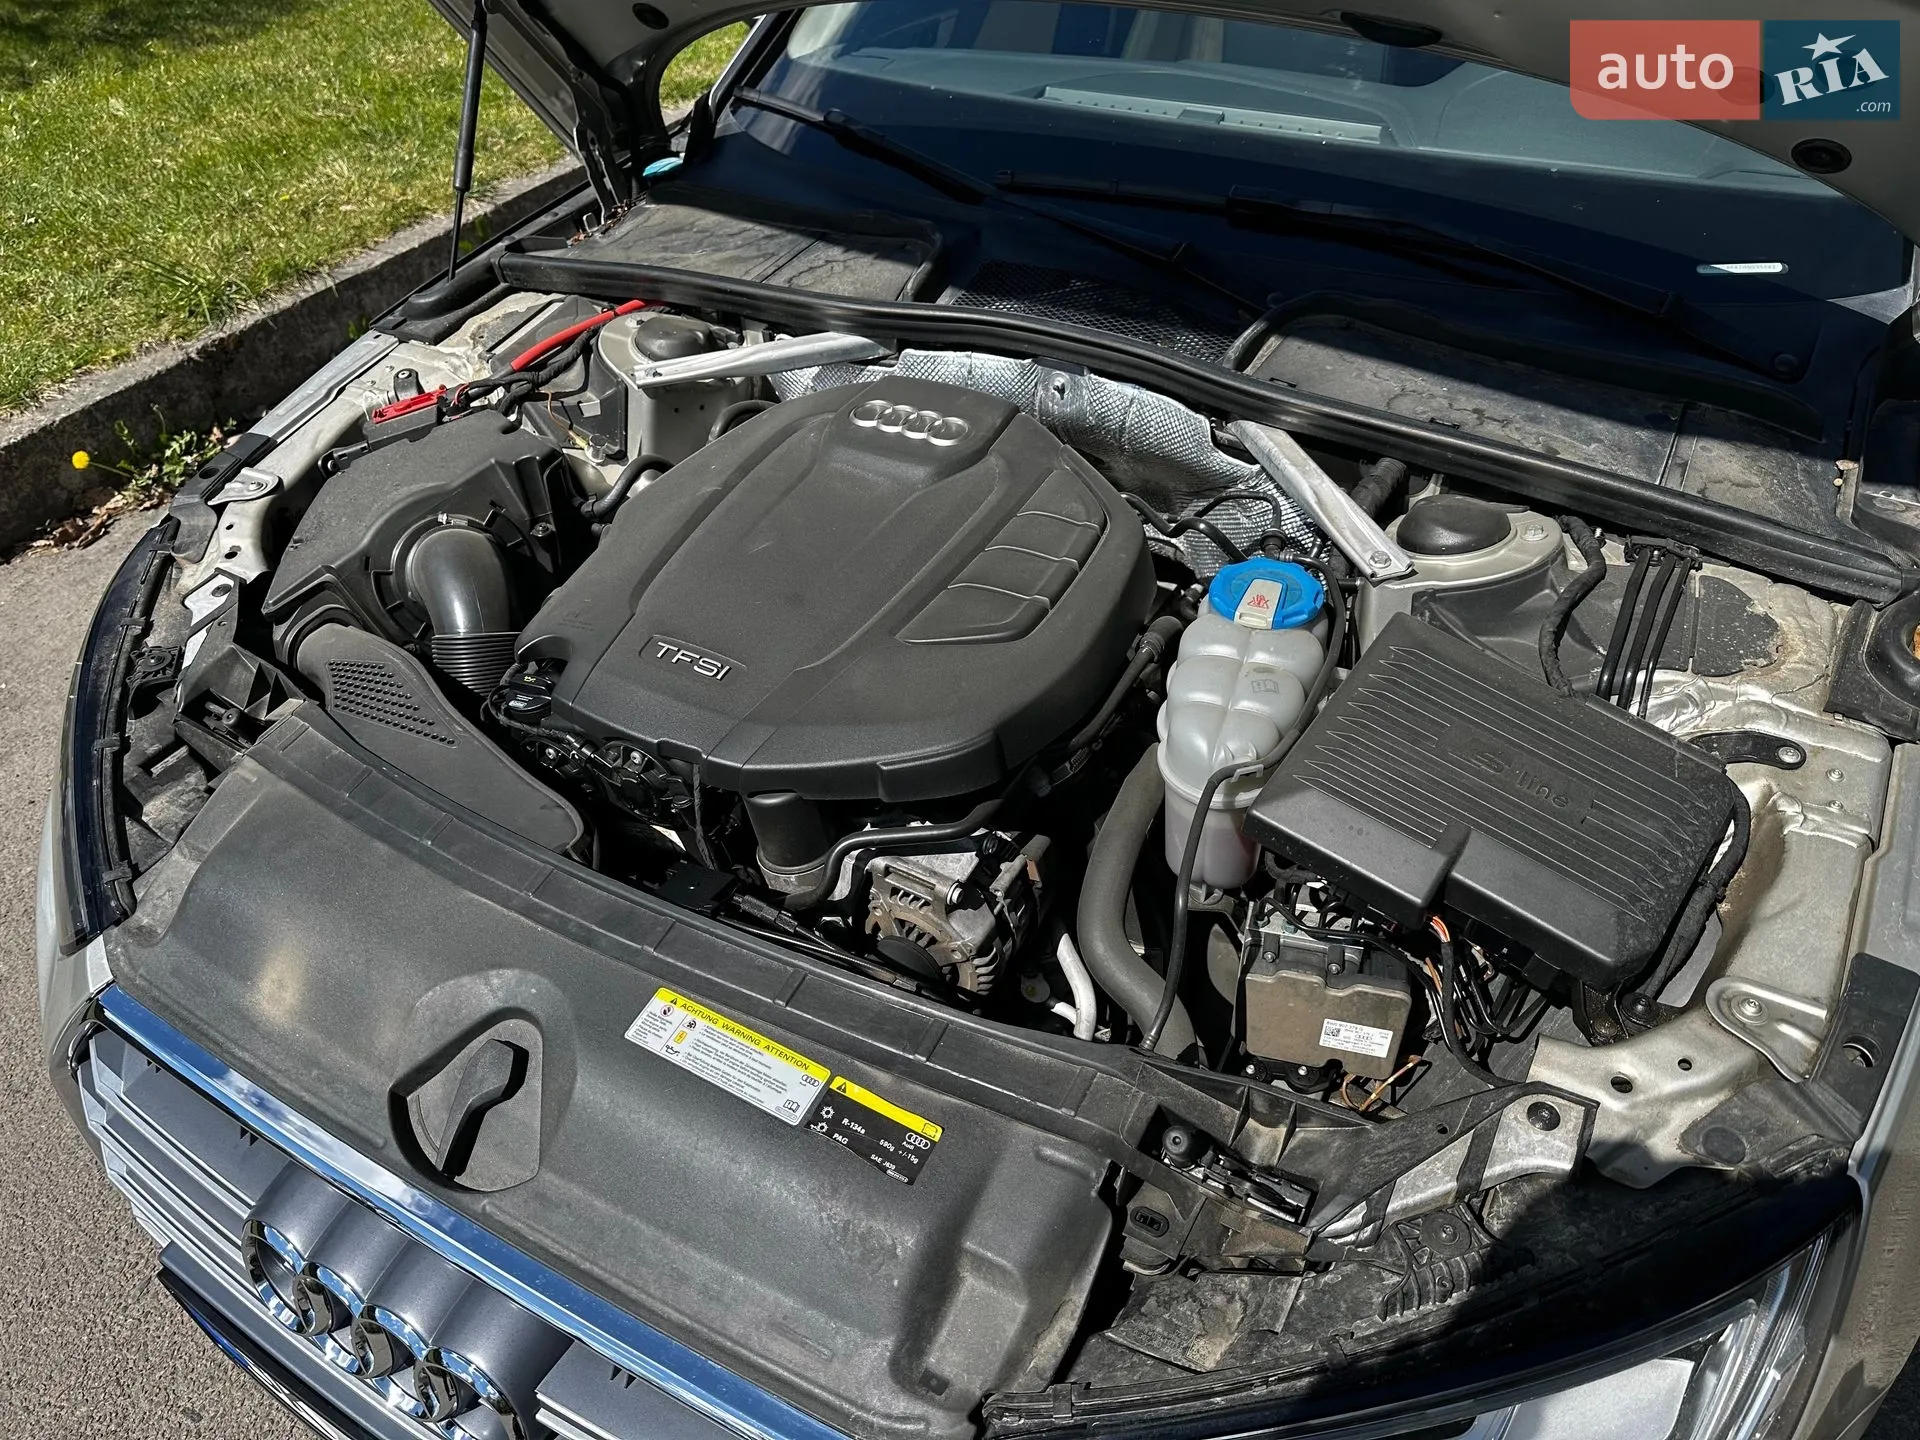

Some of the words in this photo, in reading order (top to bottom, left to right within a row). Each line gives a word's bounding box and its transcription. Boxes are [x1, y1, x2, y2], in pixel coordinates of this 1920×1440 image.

[656, 641, 731, 680] TFSI
[1516, 769, 1569, 808] line
[680, 1003, 720, 1025] ACHTUNG
[721, 1022, 761, 1046] WARNING
[764, 1044, 810, 1071] ATTENTION
[841, 1118, 866, 1134] R-134a
[832, 1133, 849, 1144] PAG
[879, 1139, 895, 1152] 590g
[902, 1141, 915, 1150] Audi
[870, 1154, 882, 1164] SAE
